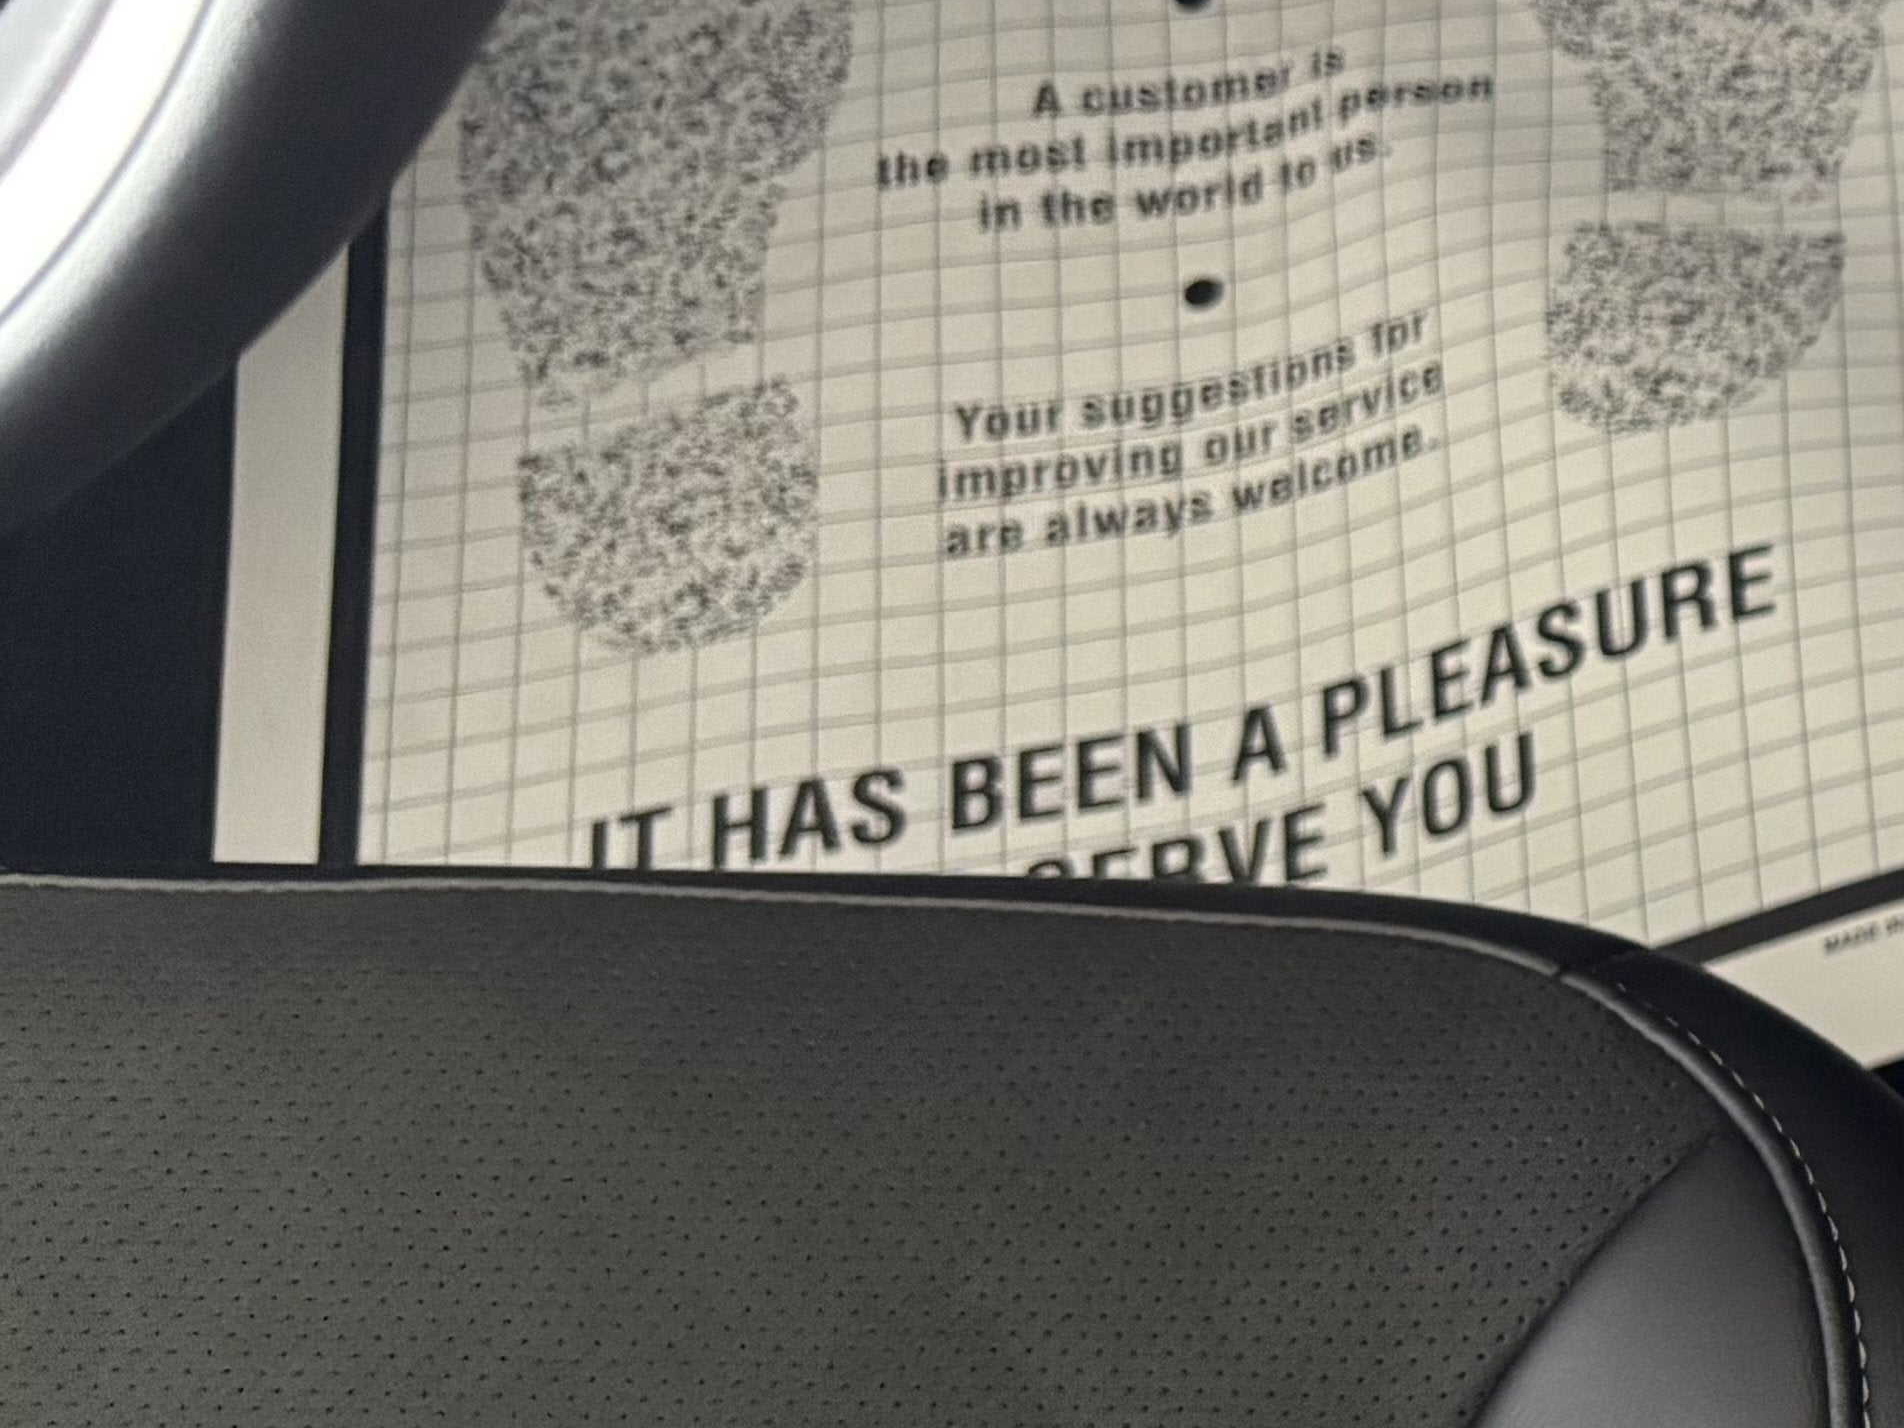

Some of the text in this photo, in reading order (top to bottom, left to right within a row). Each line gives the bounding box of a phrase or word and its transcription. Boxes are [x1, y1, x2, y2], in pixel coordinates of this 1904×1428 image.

[878, 73, 1496, 191] the most important person
[1032, 47, 1345, 119] A customer is
[980, 189, 1023, 233] in
[1038, 187, 1117, 229] the
[1134, 175, 1265, 220] world
[1279, 164, 1317, 197] to
[936, 361, 1446, 505] improving our service
[954, 311, 1430, 443] Your suggestions for
[946, 420, 1441, 559] are always welcome.
[590, 542, 1777, 872] IT HAS BEEN A PLEASURE
[1024, 732, 1537, 889] RVE YOU
